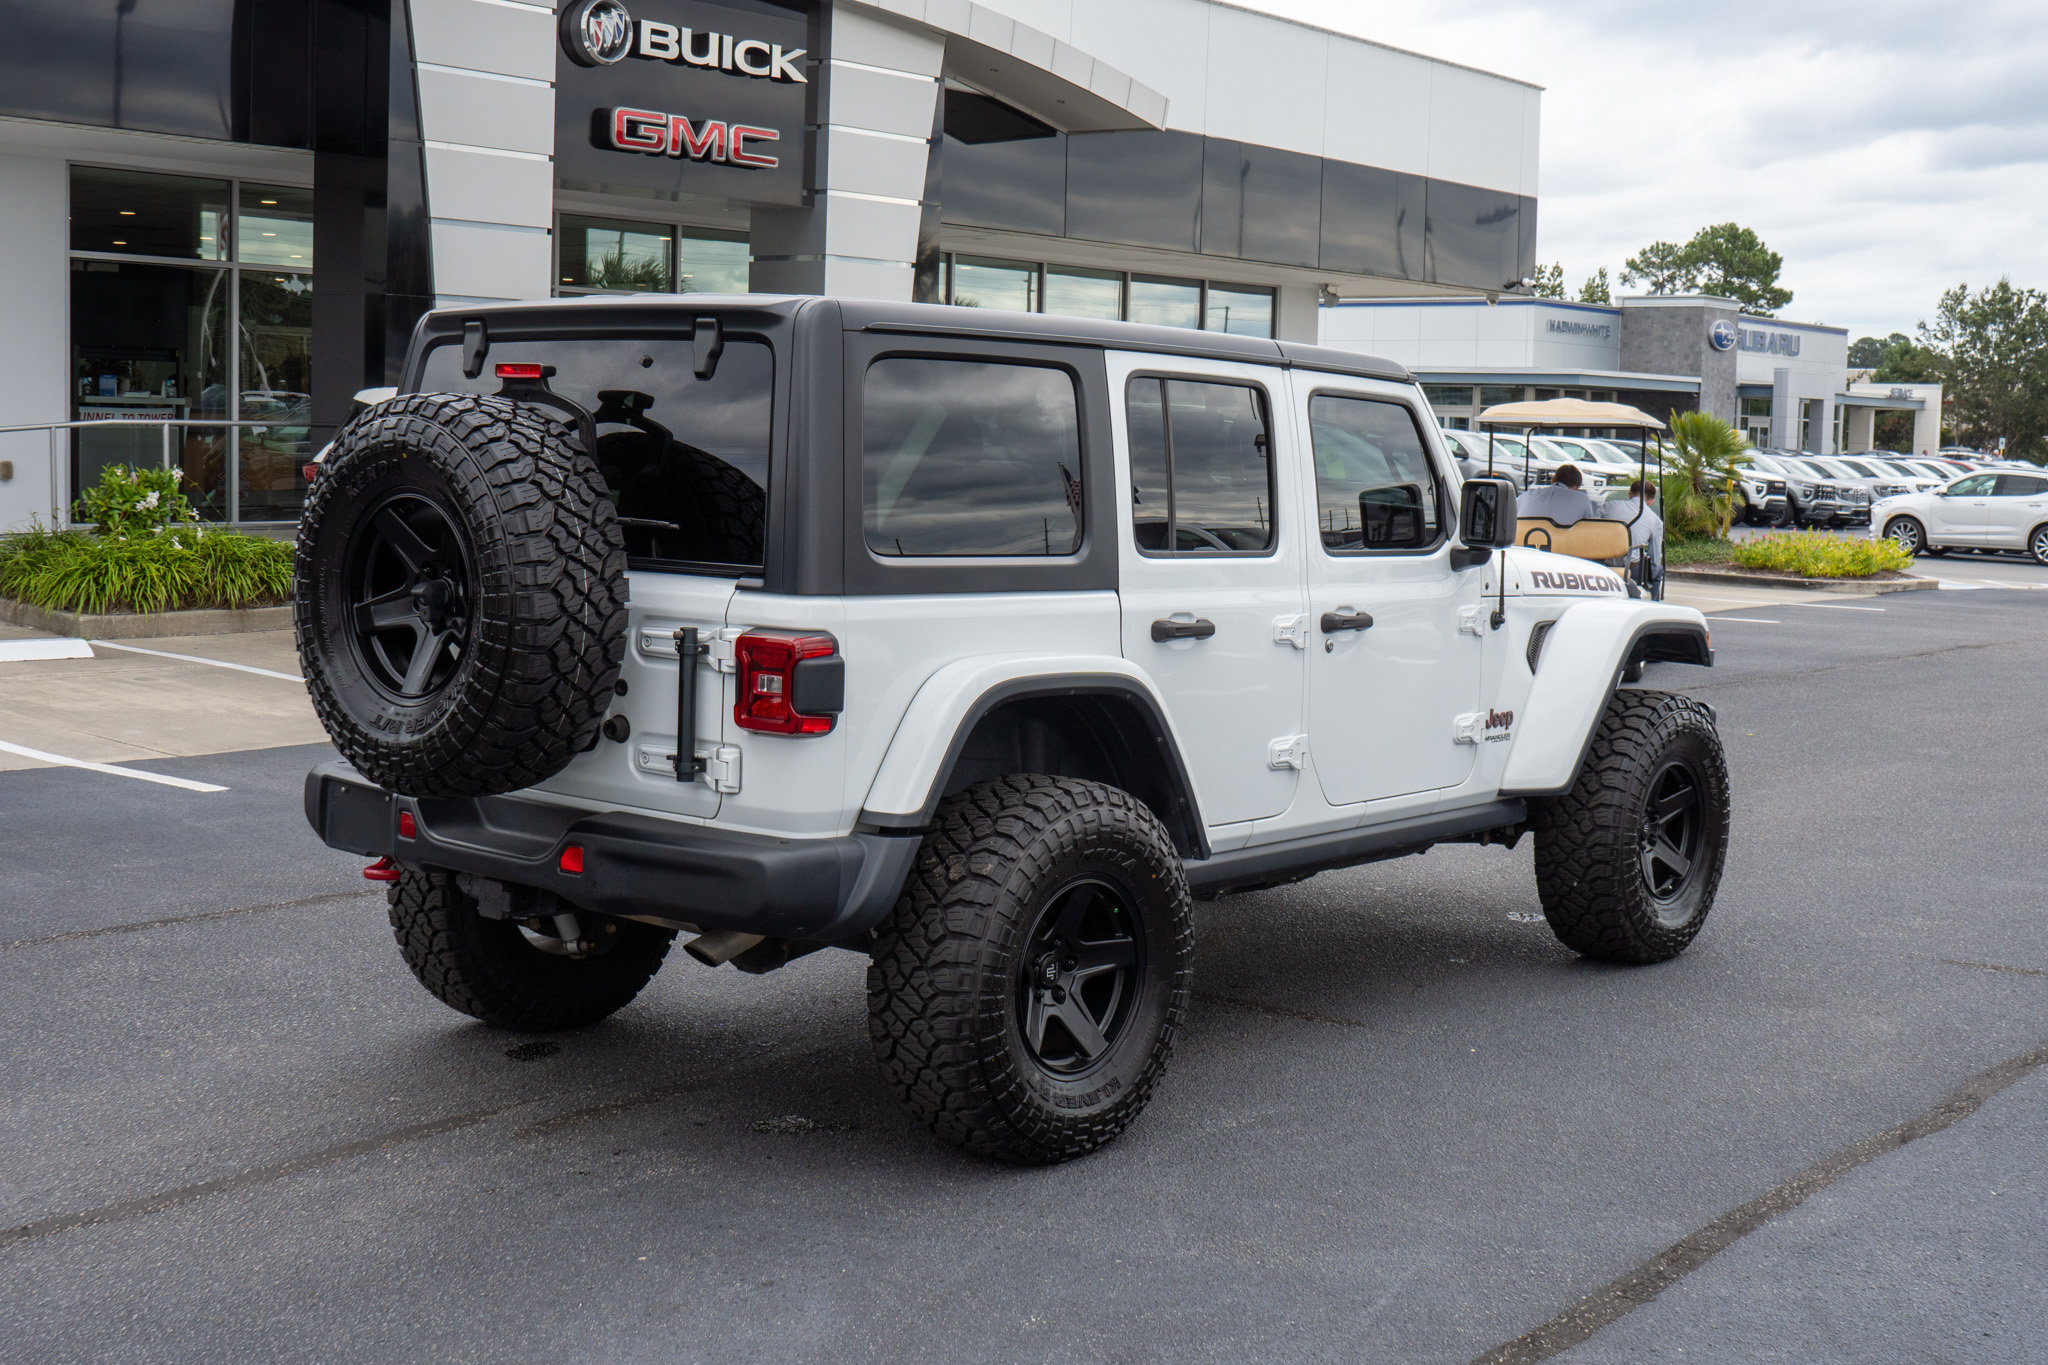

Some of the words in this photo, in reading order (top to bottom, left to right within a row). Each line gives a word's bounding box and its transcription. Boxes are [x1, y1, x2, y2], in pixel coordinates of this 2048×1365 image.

[640, 19, 808, 83] BUICK
[610, 106, 780, 168] GMC
[1530, 570, 1622, 593] RUBICON
[1485, 708, 1514, 731] Jeep
